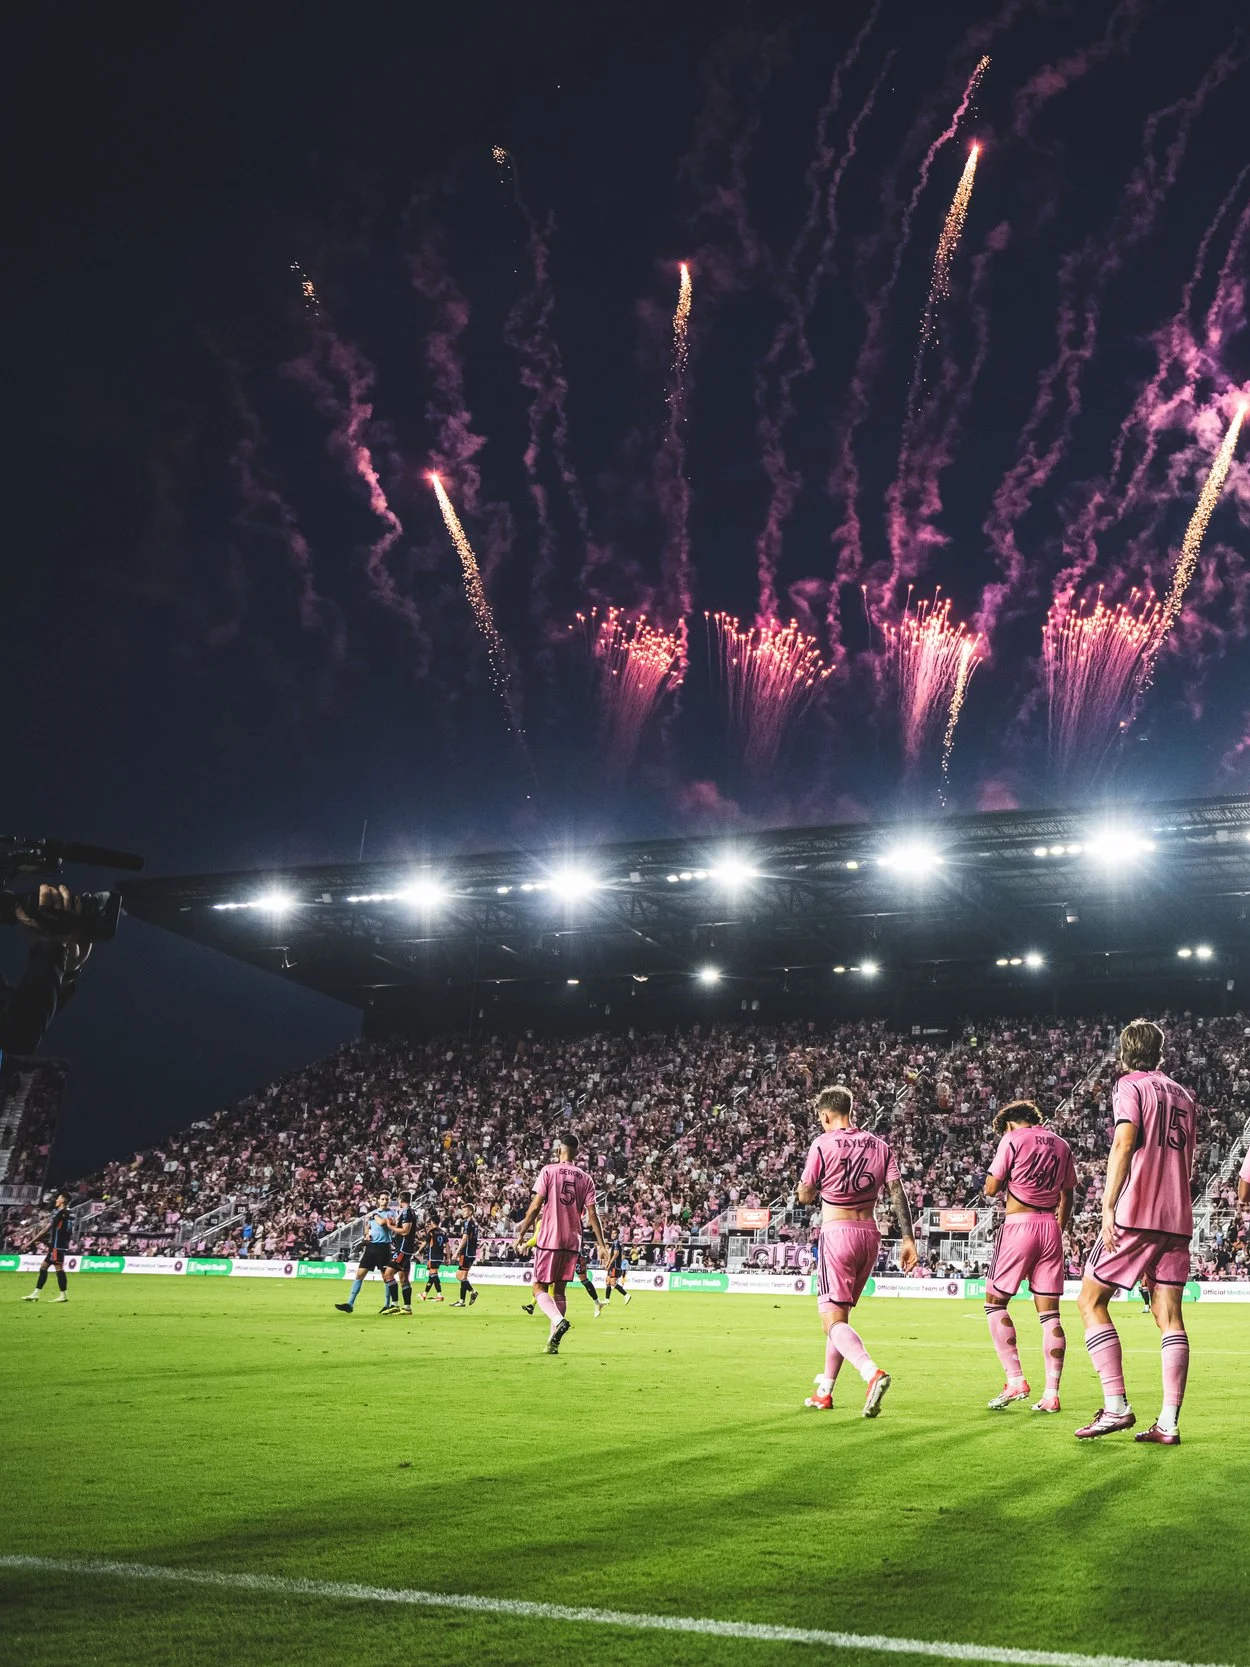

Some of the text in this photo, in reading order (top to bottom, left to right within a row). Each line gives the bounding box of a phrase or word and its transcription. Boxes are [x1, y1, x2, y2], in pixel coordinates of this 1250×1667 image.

[1157, 1100, 1188, 1152] 15
[835, 1138, 877, 1150] TAYLOR
[840, 1157, 876, 1194] 16
[560, 1181, 576, 1206] 5
[437, 1235, 443, 1245] 9
[681, 1279, 721, 1288] Baptist Health
